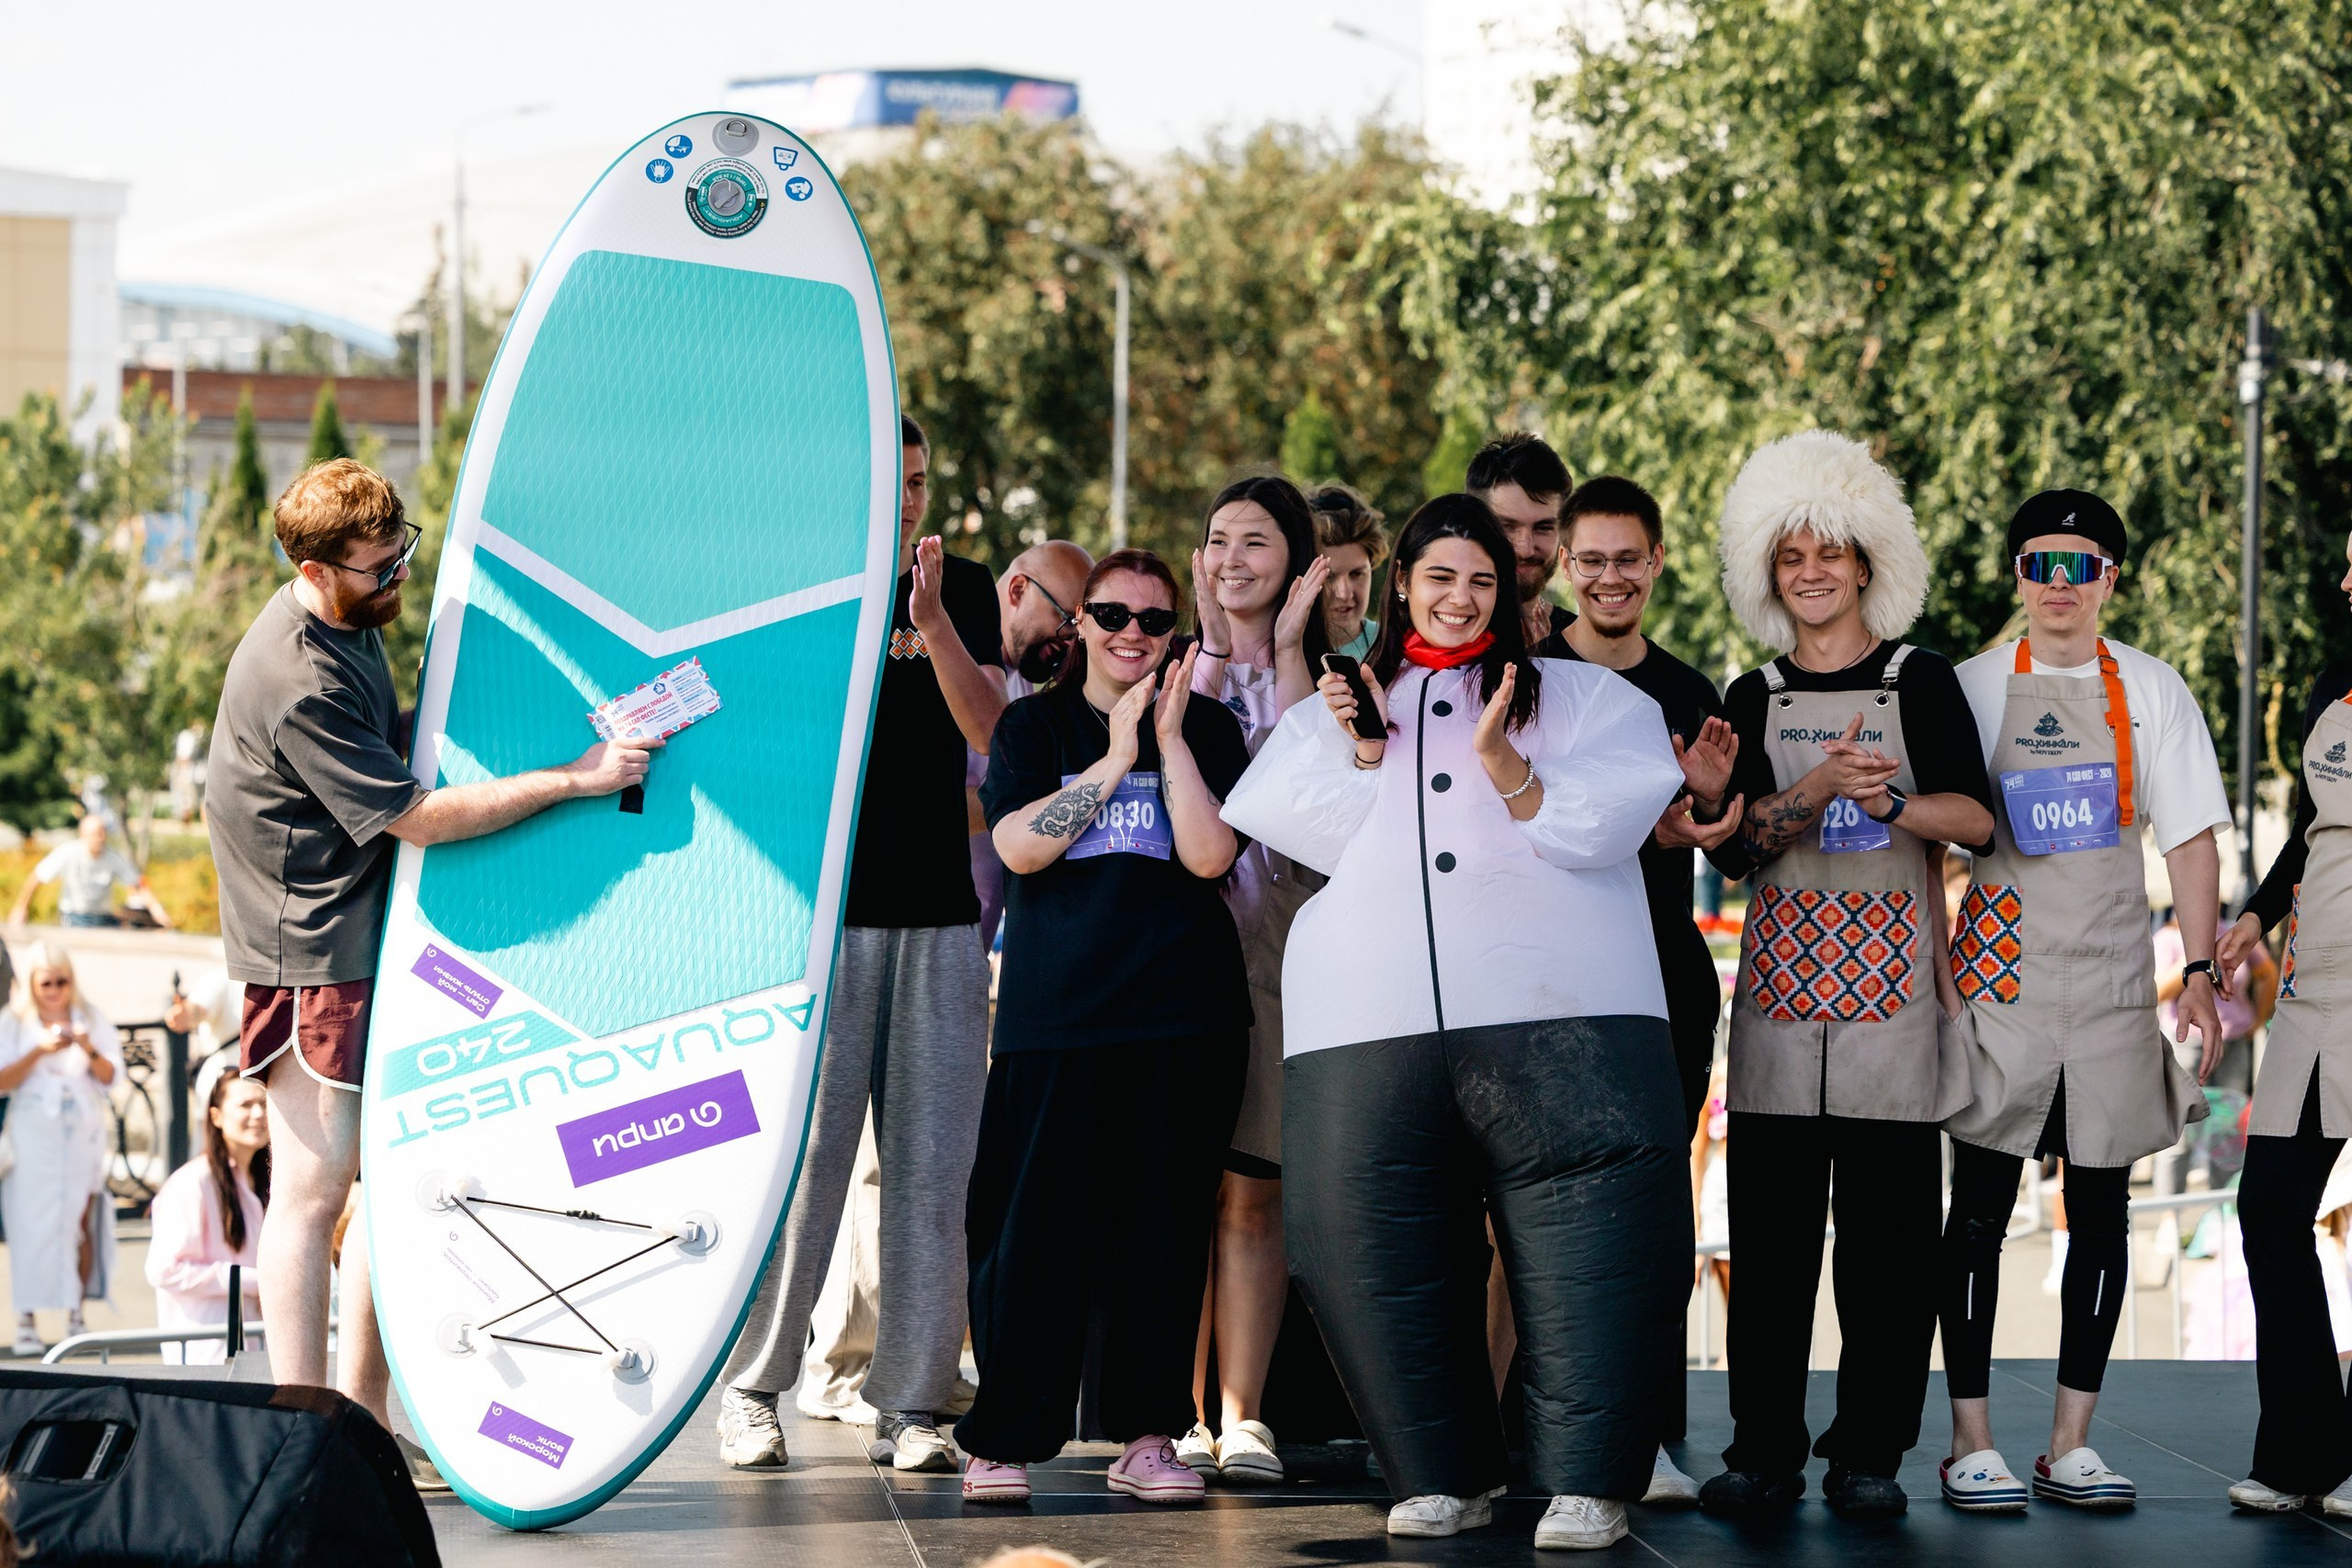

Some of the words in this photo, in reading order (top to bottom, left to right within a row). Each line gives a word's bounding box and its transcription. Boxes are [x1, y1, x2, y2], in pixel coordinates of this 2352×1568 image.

[704, 209, 743, 223] AQUAQUEST
[613, 705, 647, 725] ПОЗДРАВЛЯЕМ
[651, 691, 673, 708] ПОБЕДОЙ
[631, 716, 641, 725] САП
[640, 709, 657, 722] ФЕСТЕ!
[1095, 801, 1155, 830] 0830
[2032, 798, 2093, 831] 0964
[433, 965, 464, 988] жизни
[437, 977, 458, 992] мой
[463, 985, 490, 1004] стиль
[466, 996, 485, 1012] Сап
[416, 1018, 531, 1077] 240
[388, 993, 817, 1149] AQUAQUEST
[536, 1435, 565, 1453] волк
